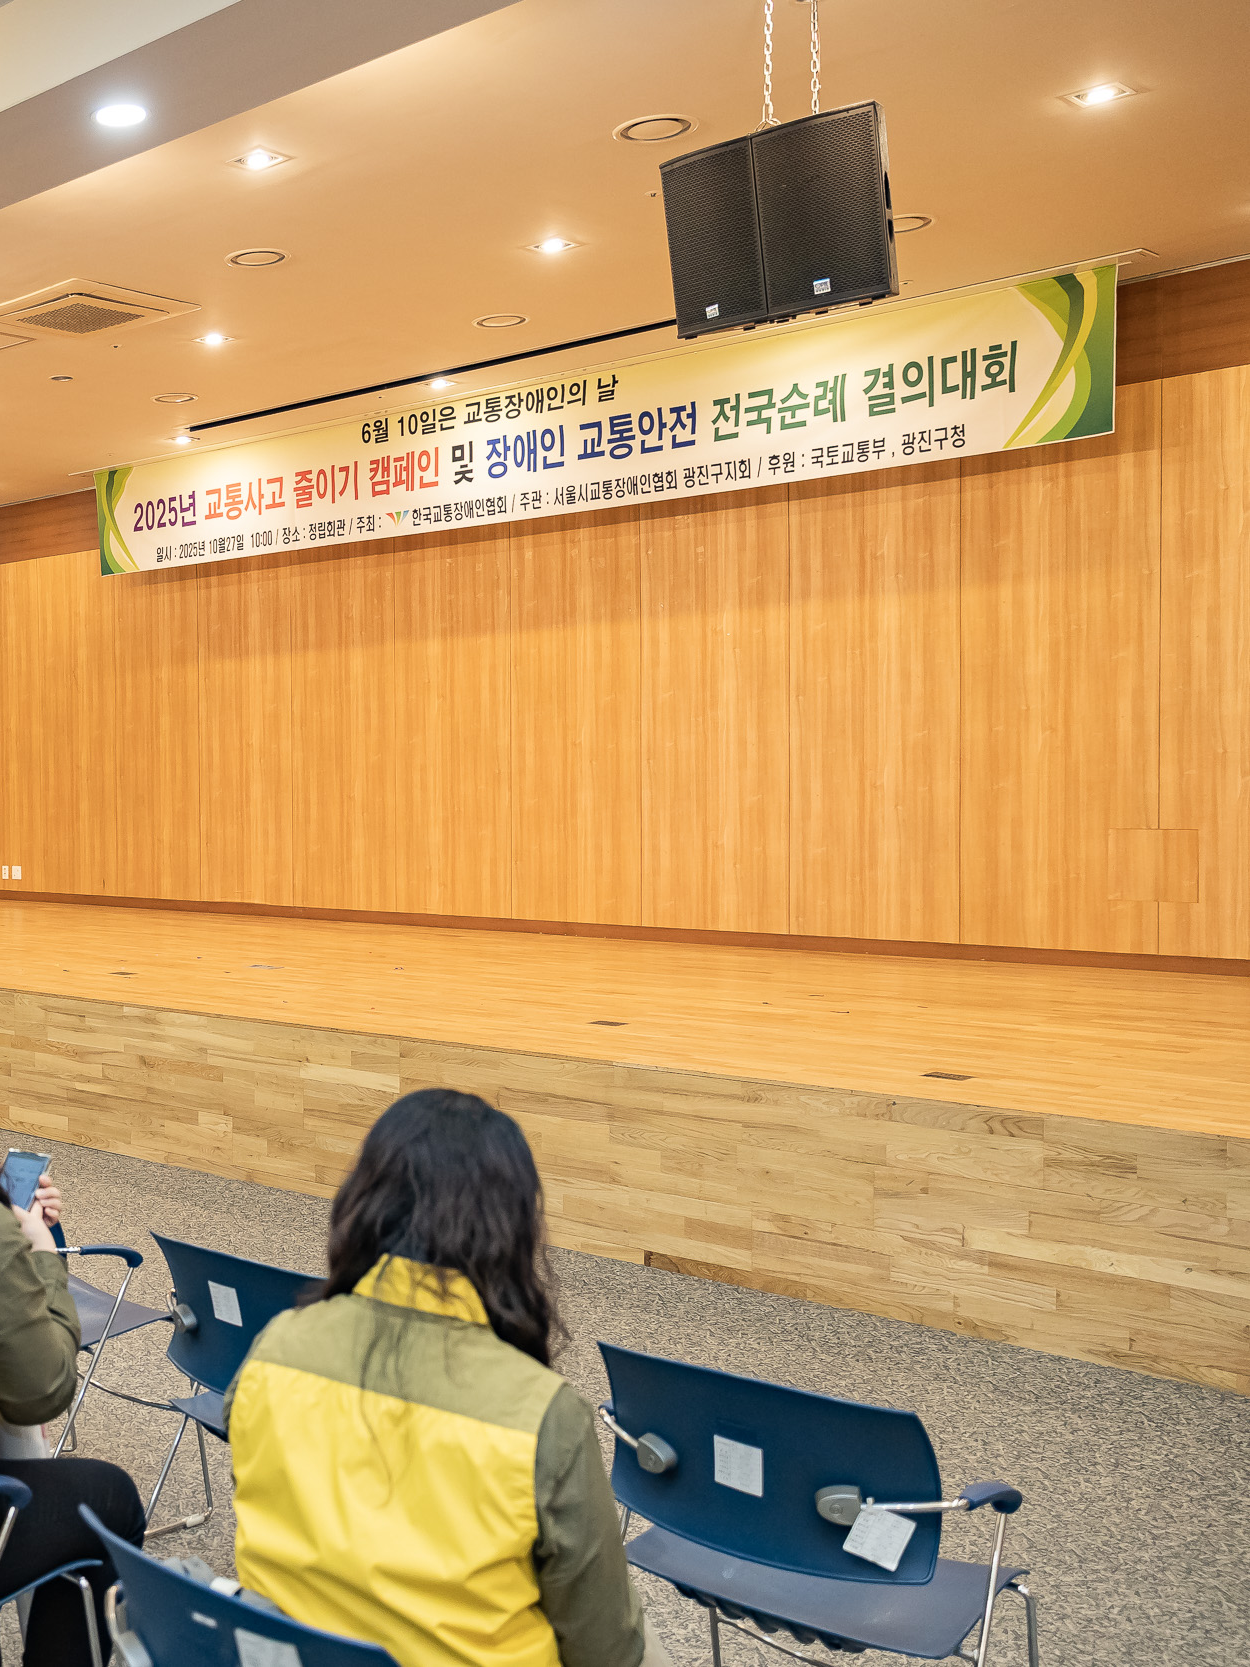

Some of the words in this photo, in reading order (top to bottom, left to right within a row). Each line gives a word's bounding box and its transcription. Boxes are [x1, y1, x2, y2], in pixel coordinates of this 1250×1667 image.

[133, 490, 197, 532] 2025년
[204, 476, 286, 521] 교통사고
[293, 460, 359, 509] 줄이기
[368, 447, 439, 498] 캠페인
[451, 441, 474, 485] 및
[486, 424, 565, 479] 장애인
[577, 401, 697, 460] 교통안전
[711, 373, 847, 442] 전국순례
[863, 340, 1018, 417] 결의대회
[362, 418, 389, 443] 6월
[397, 406, 457, 436] 10일은
[463, 379, 587, 425] 교통장애인의
[597, 374, 619, 402] 날
[179, 540, 205, 559] 2025년
[209, 534, 244, 554] 10월27일
[250, 530, 273, 549] 10:00
[308, 518, 346, 541] 정립회관
[412, 495, 507, 527] 한국교통장애인협회
[553, 469, 678, 507] 서울시교통장애인협회
[683, 458, 751, 489] 광진구지회
[901, 423, 966, 456] 광진구청
